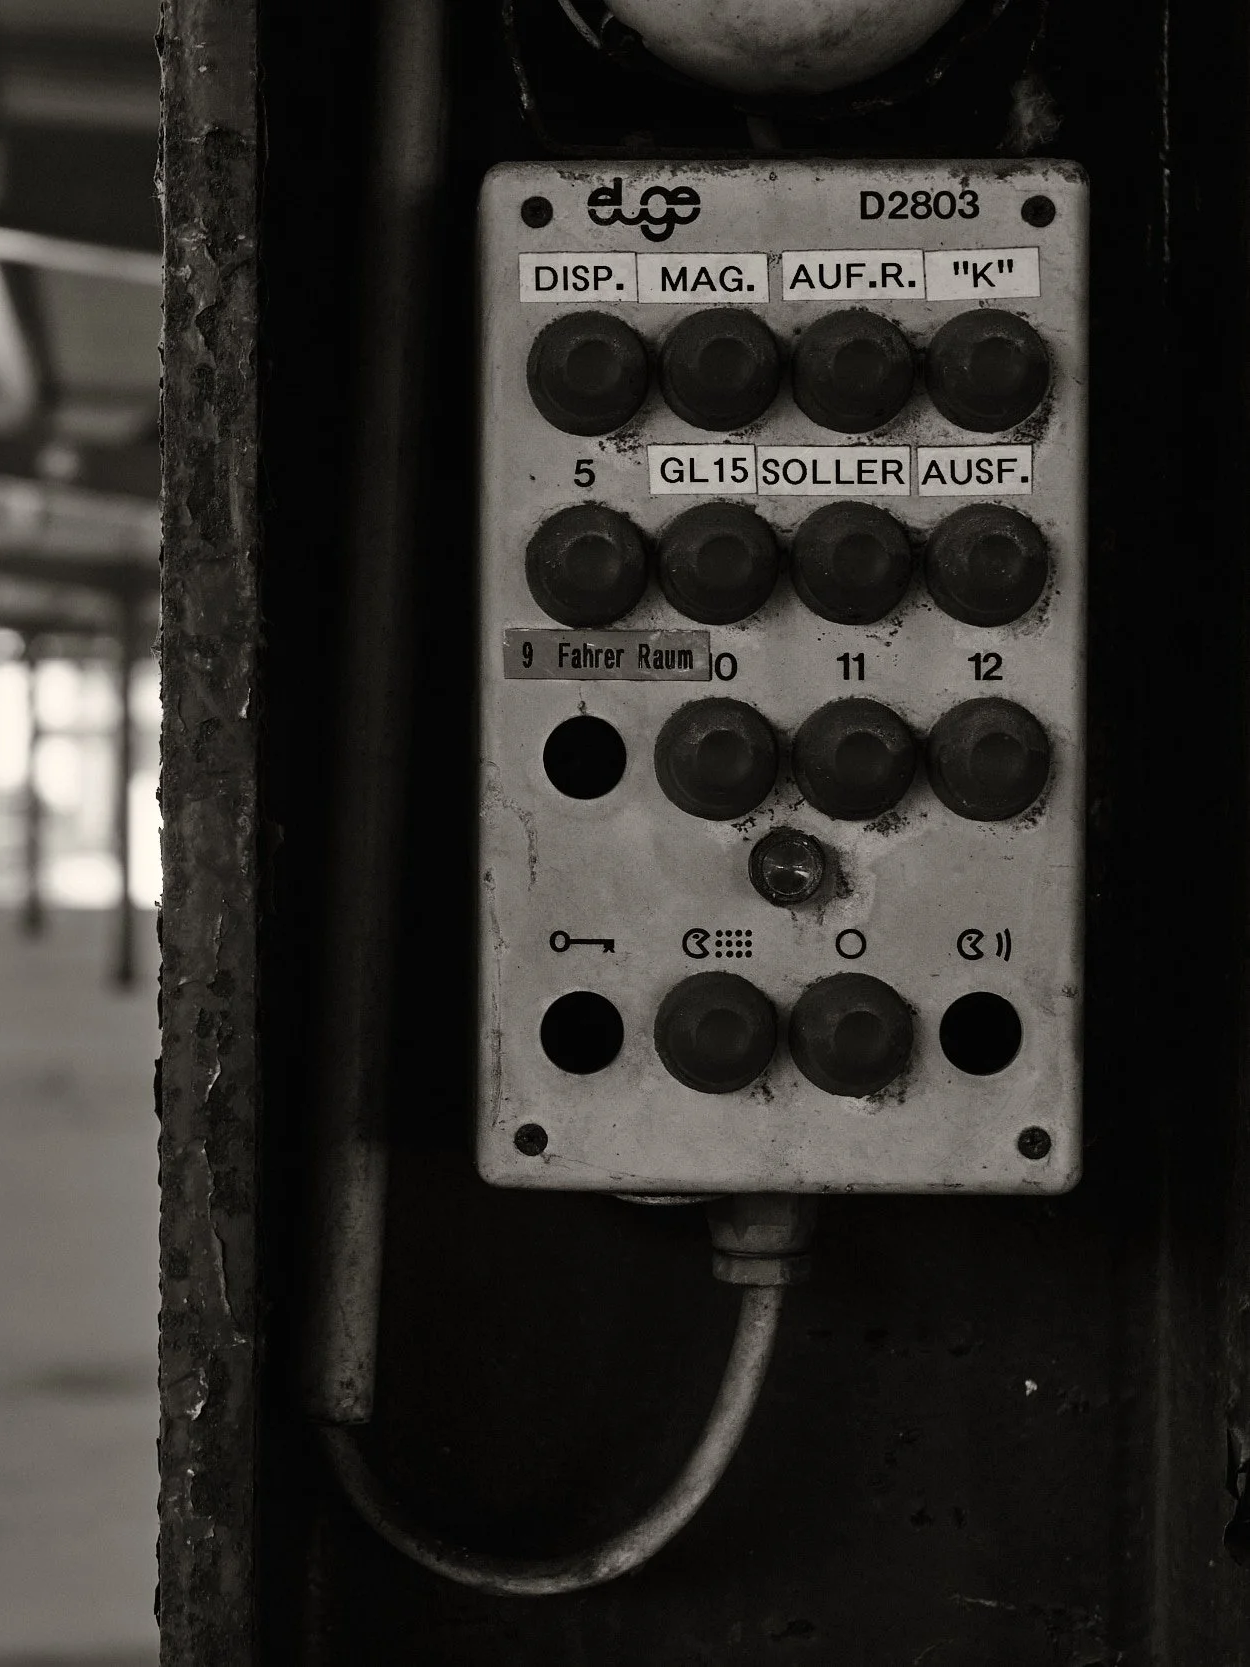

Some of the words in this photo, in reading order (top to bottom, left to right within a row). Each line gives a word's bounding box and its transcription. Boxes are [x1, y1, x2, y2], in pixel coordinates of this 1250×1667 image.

[860, 190, 980, 220] D2803
[534, 265, 624, 292] DISP.
[661, 265, 755, 292] MAG.
[790, 262, 916, 290] AUF.R.
[953, 259, 1014, 288] "K"
[574, 459, 596, 488] 5
[660, 457, 749, 484] GL15
[762, 458, 906, 486] SOLLER
[922, 458, 1030, 486] AUSF.
[522, 641, 534, 669] 9
[558, 642, 625, 669] Fahrer
[638, 643, 694, 670] Raum
[836, 653, 865, 681] 11
[967, 652, 1004, 681] 12
